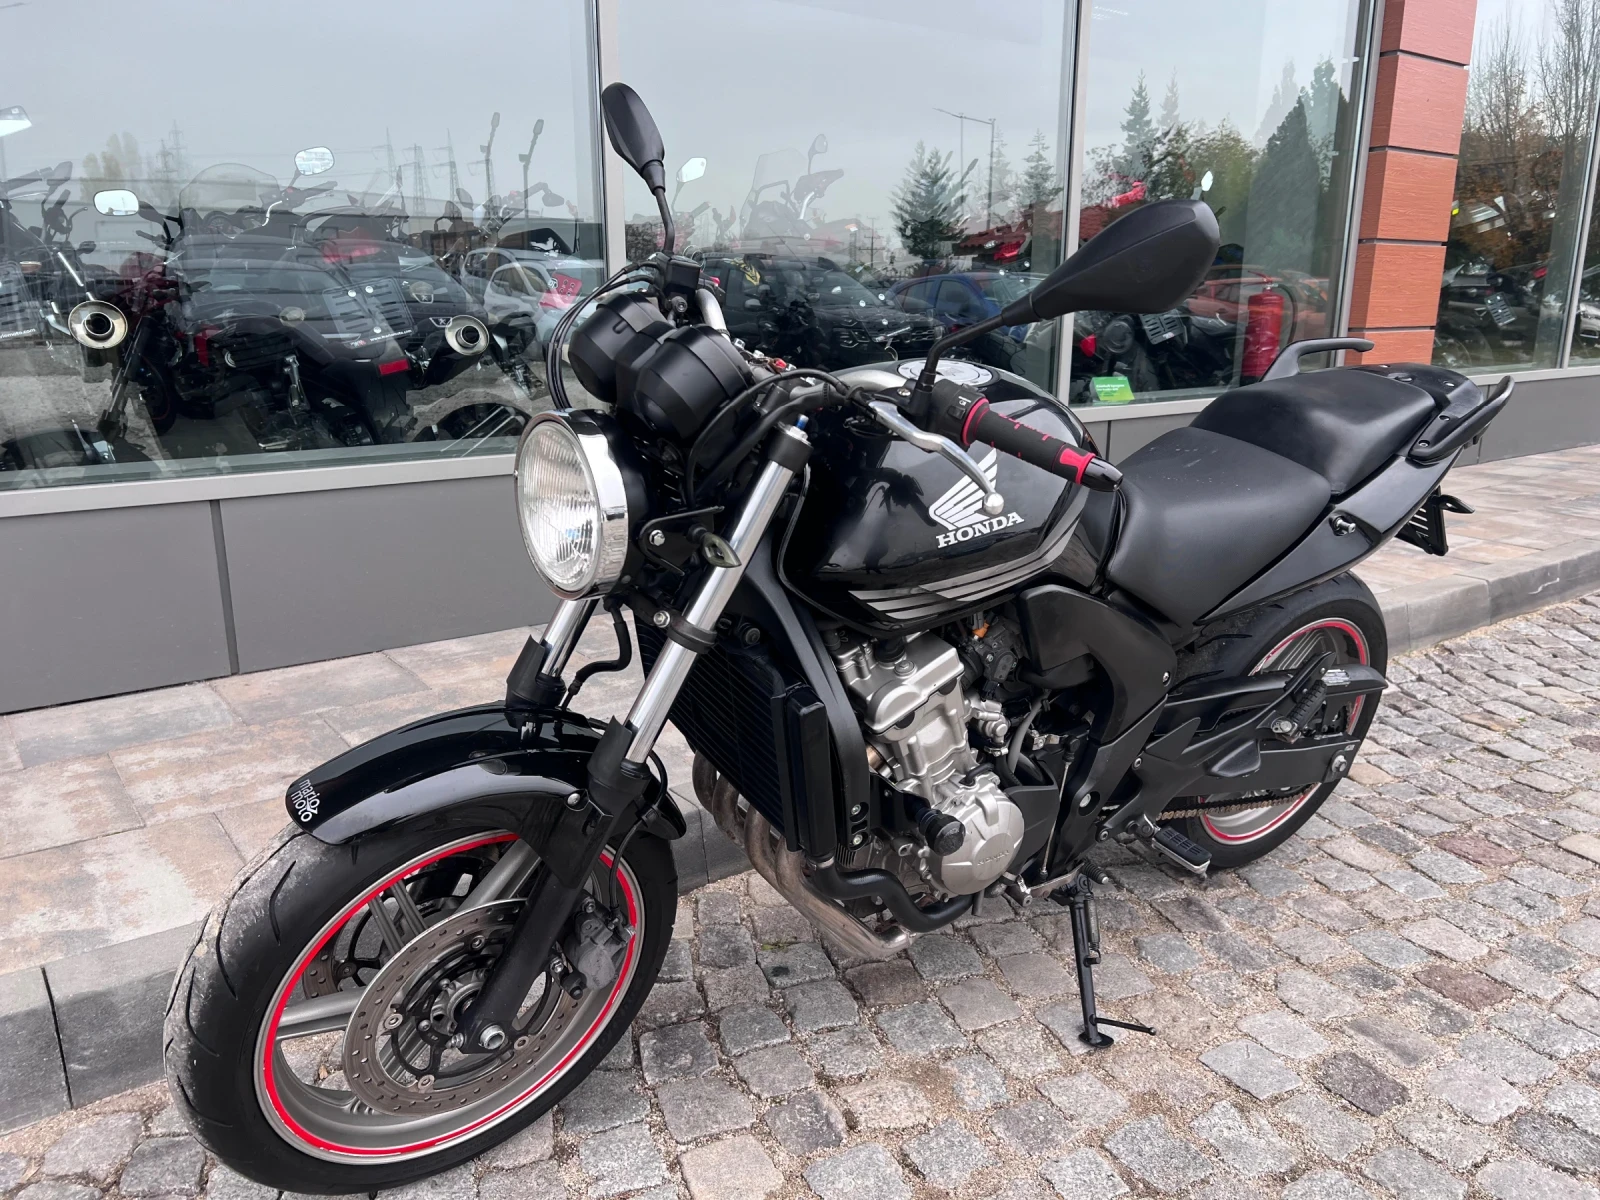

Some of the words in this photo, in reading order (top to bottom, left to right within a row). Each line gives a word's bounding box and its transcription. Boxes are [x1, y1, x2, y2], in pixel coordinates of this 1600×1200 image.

[935, 511, 1025, 548] HONDA
[290, 790, 313, 822] moto
[298, 778, 321, 808] mario
